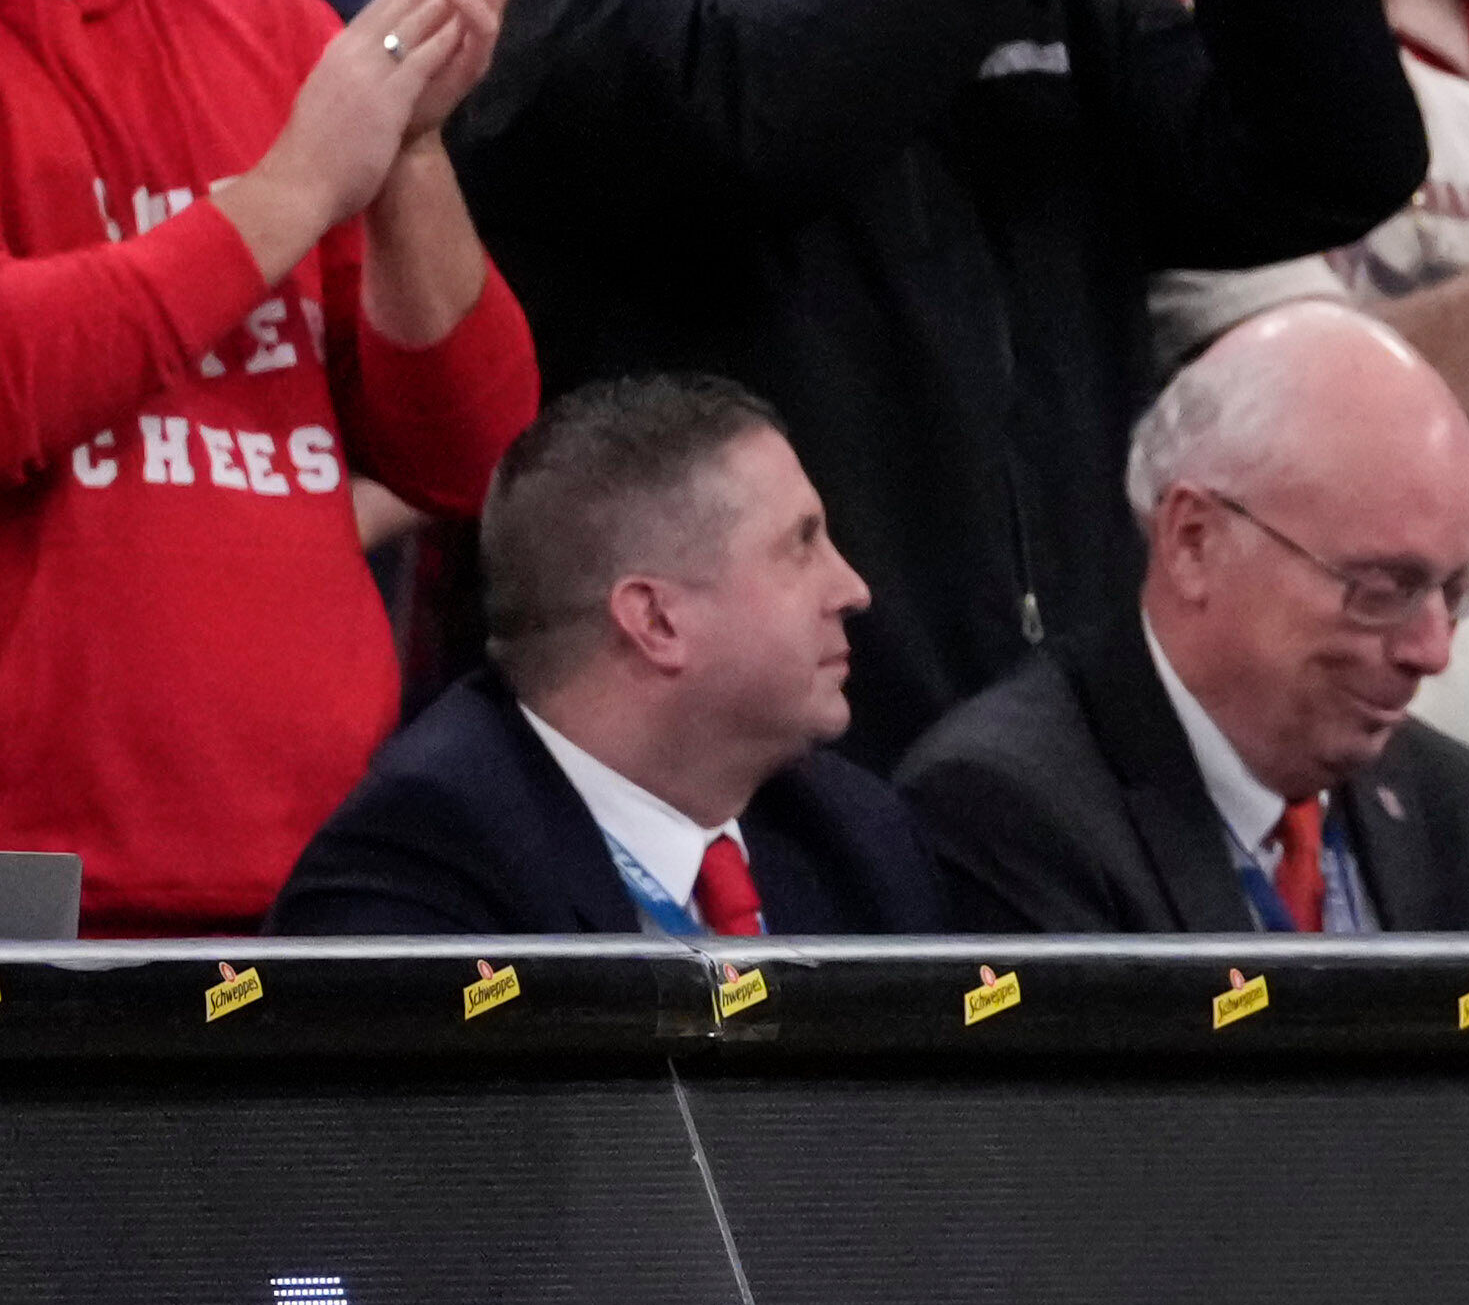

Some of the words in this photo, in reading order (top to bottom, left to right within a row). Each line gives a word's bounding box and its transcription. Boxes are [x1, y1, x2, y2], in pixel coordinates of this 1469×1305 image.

[209, 976, 259, 1017] Schweppes
[468, 974, 516, 1014] Schweppes
[722, 977, 763, 1009] hweppes
[969, 982, 1017, 1020] Schweppes
